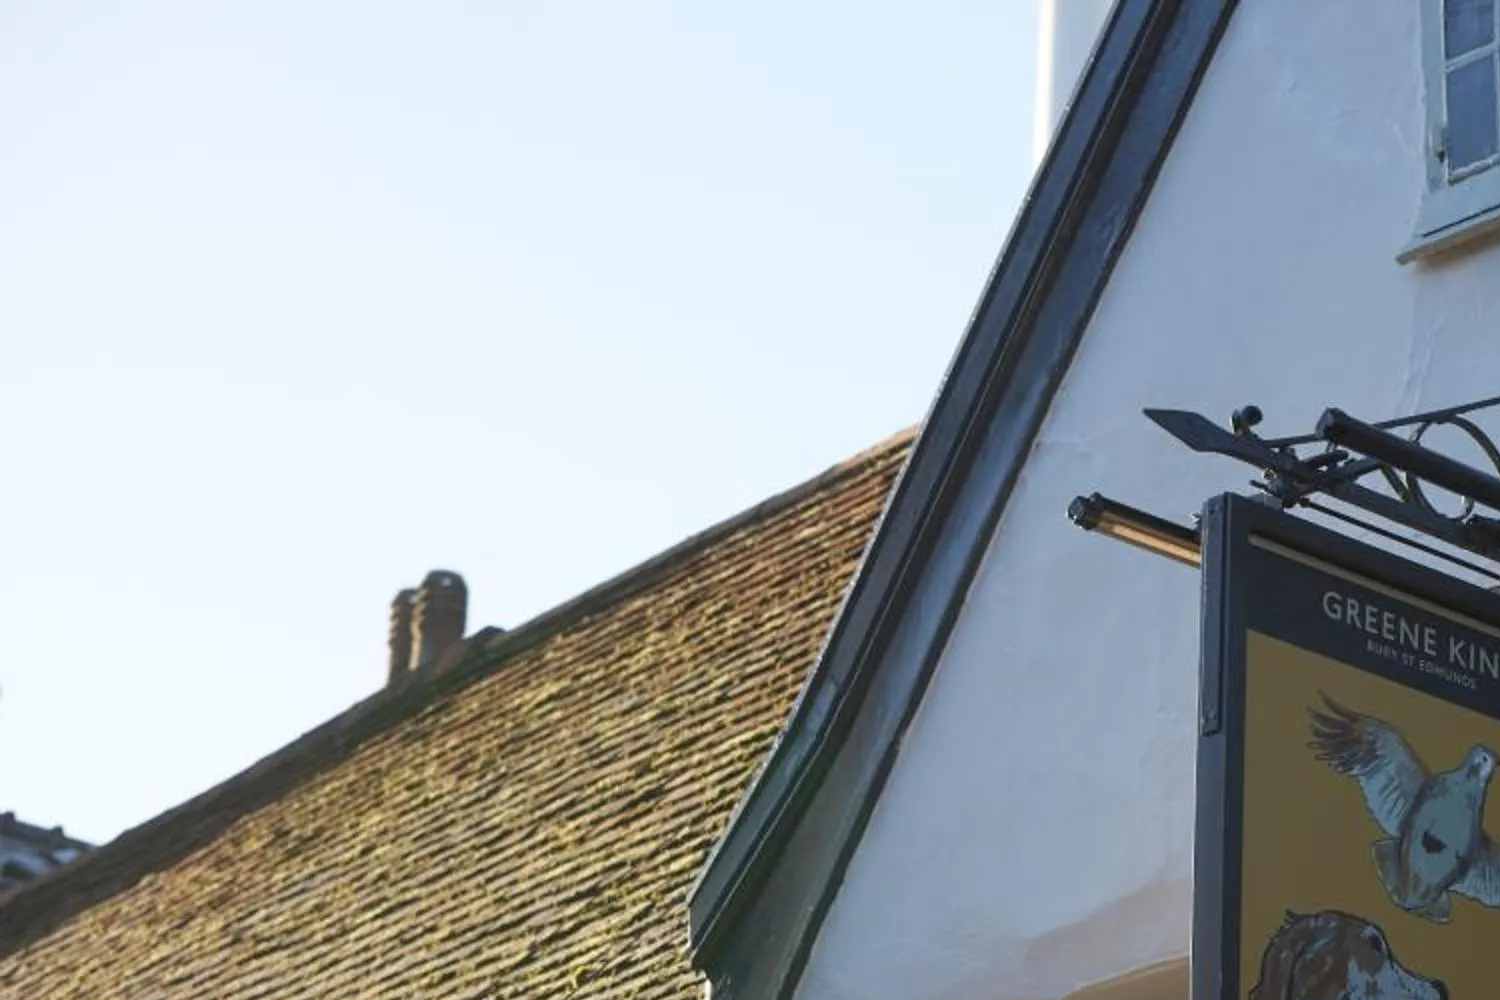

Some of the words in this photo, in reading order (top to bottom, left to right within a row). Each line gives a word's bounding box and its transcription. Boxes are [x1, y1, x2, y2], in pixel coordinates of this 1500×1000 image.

[1322, 591, 1437, 656] GREENE
[1366, 639, 1398, 660] BURY
[1419, 659, 1478, 690] EDMUNDS
